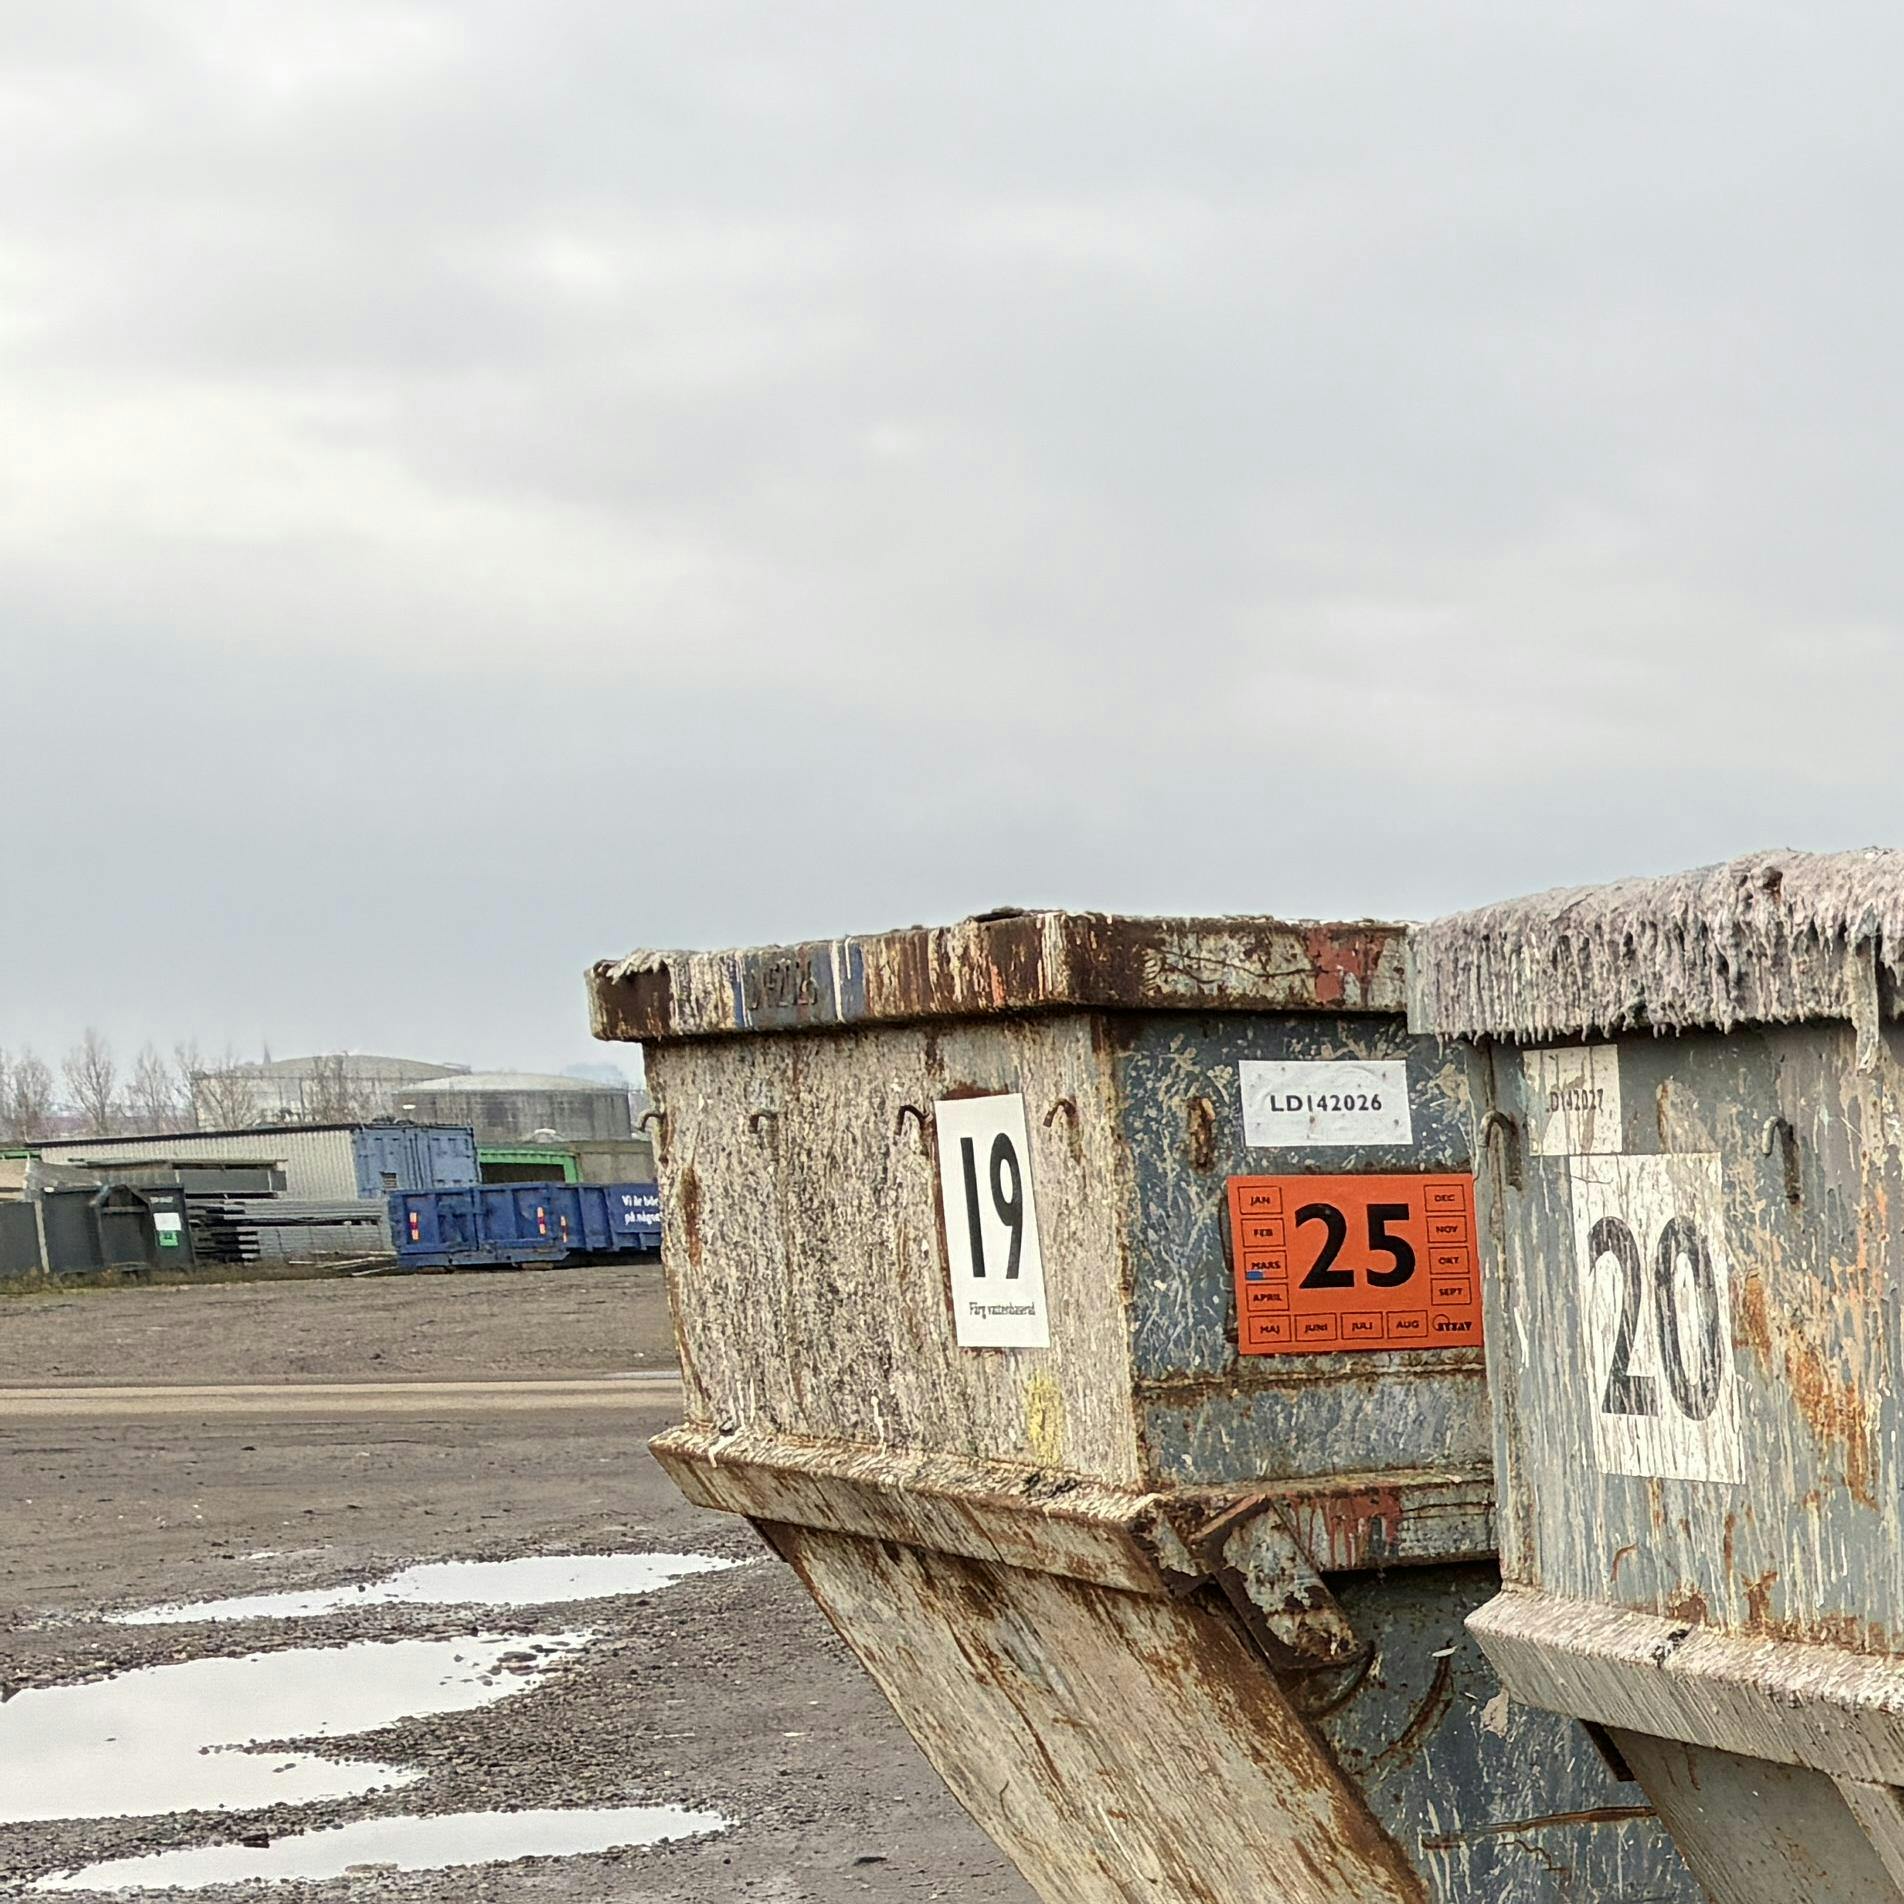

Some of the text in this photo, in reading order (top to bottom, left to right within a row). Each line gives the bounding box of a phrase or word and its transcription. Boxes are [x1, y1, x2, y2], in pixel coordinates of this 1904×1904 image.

[1270, 1094, 1382, 1112] LD142026
[1545, 1088, 1604, 1116] D142027
[1250, 1196, 1271, 1205] JAN
[1434, 1194, 1455, 1202] DEC
[960, 1132, 1024, 1280] 19
[1253, 1228, 1273, 1237] FEB
[1436, 1225, 1458, 1233] NOV
[1295, 1202, 1417, 1289] 25
[1438, 1256, 1459, 1265] OKT
[1251, 1261, 1281, 1270] MARS
[1439, 1287, 1463, 1296] SEPT
[1253, 1293, 1282, 1302] APRIL
[1588, 1215, 1725, 1422] 20
[1260, 1320, 1420, 1334] MAJ JUNI JULI AUG
